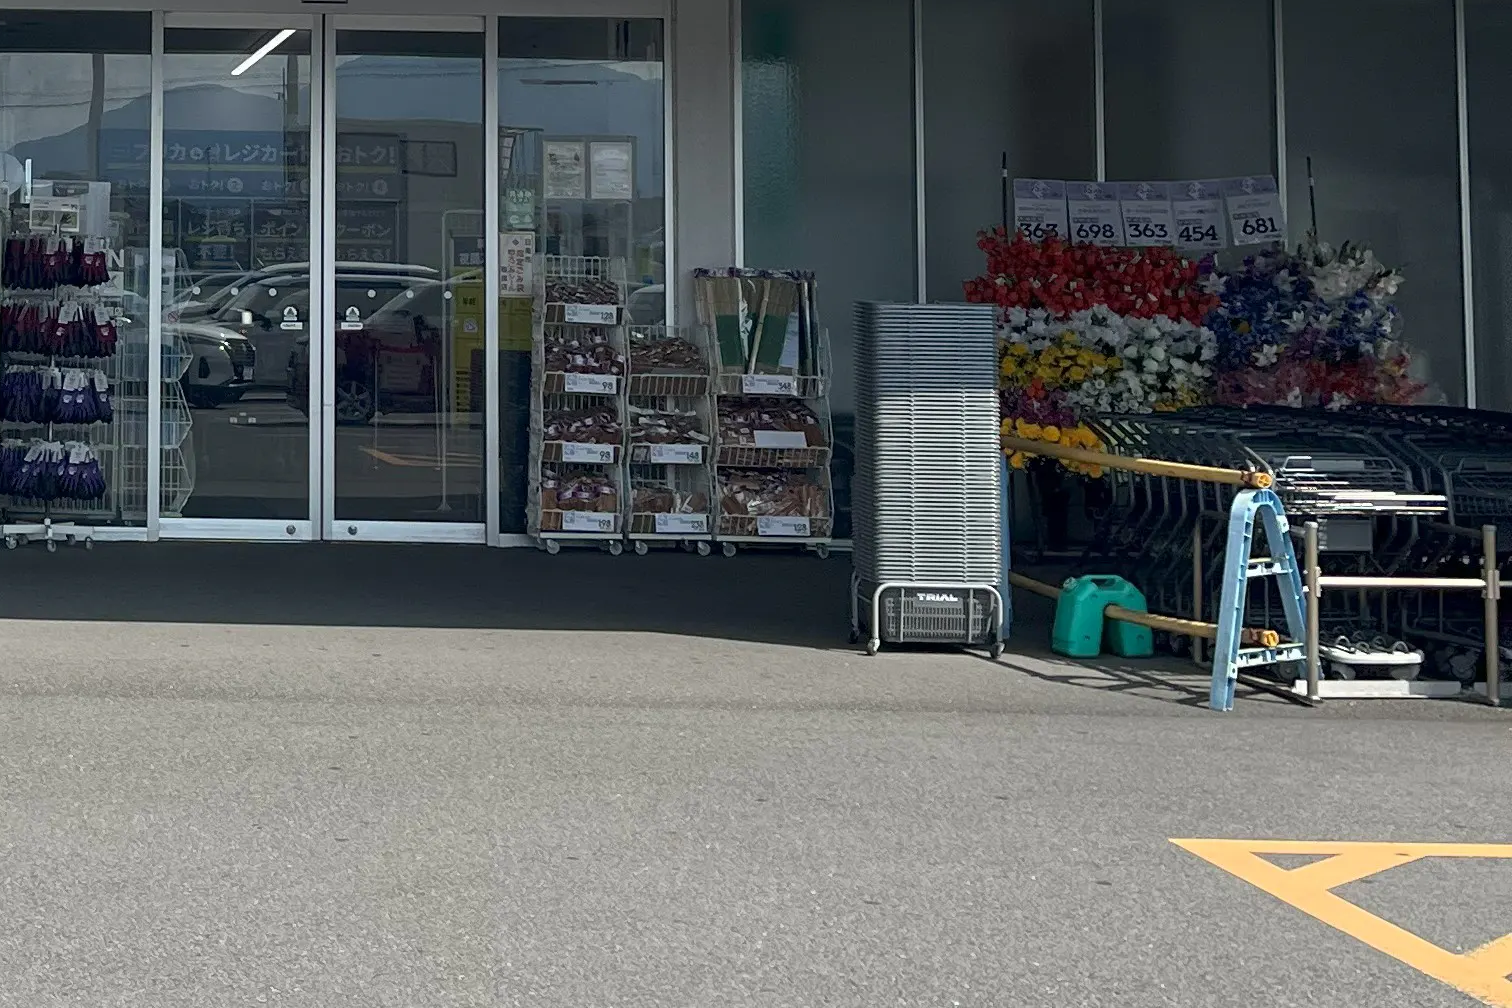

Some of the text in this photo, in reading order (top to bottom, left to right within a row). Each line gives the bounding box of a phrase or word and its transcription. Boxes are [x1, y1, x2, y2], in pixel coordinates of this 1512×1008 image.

[1076, 223, 1115, 239] 698
[1129, 223, 1168, 239] 363
[1179, 224, 1218, 242] 454
[1242, 217, 1277, 236] 681
[916, 592, 959, 602] TRIAL
